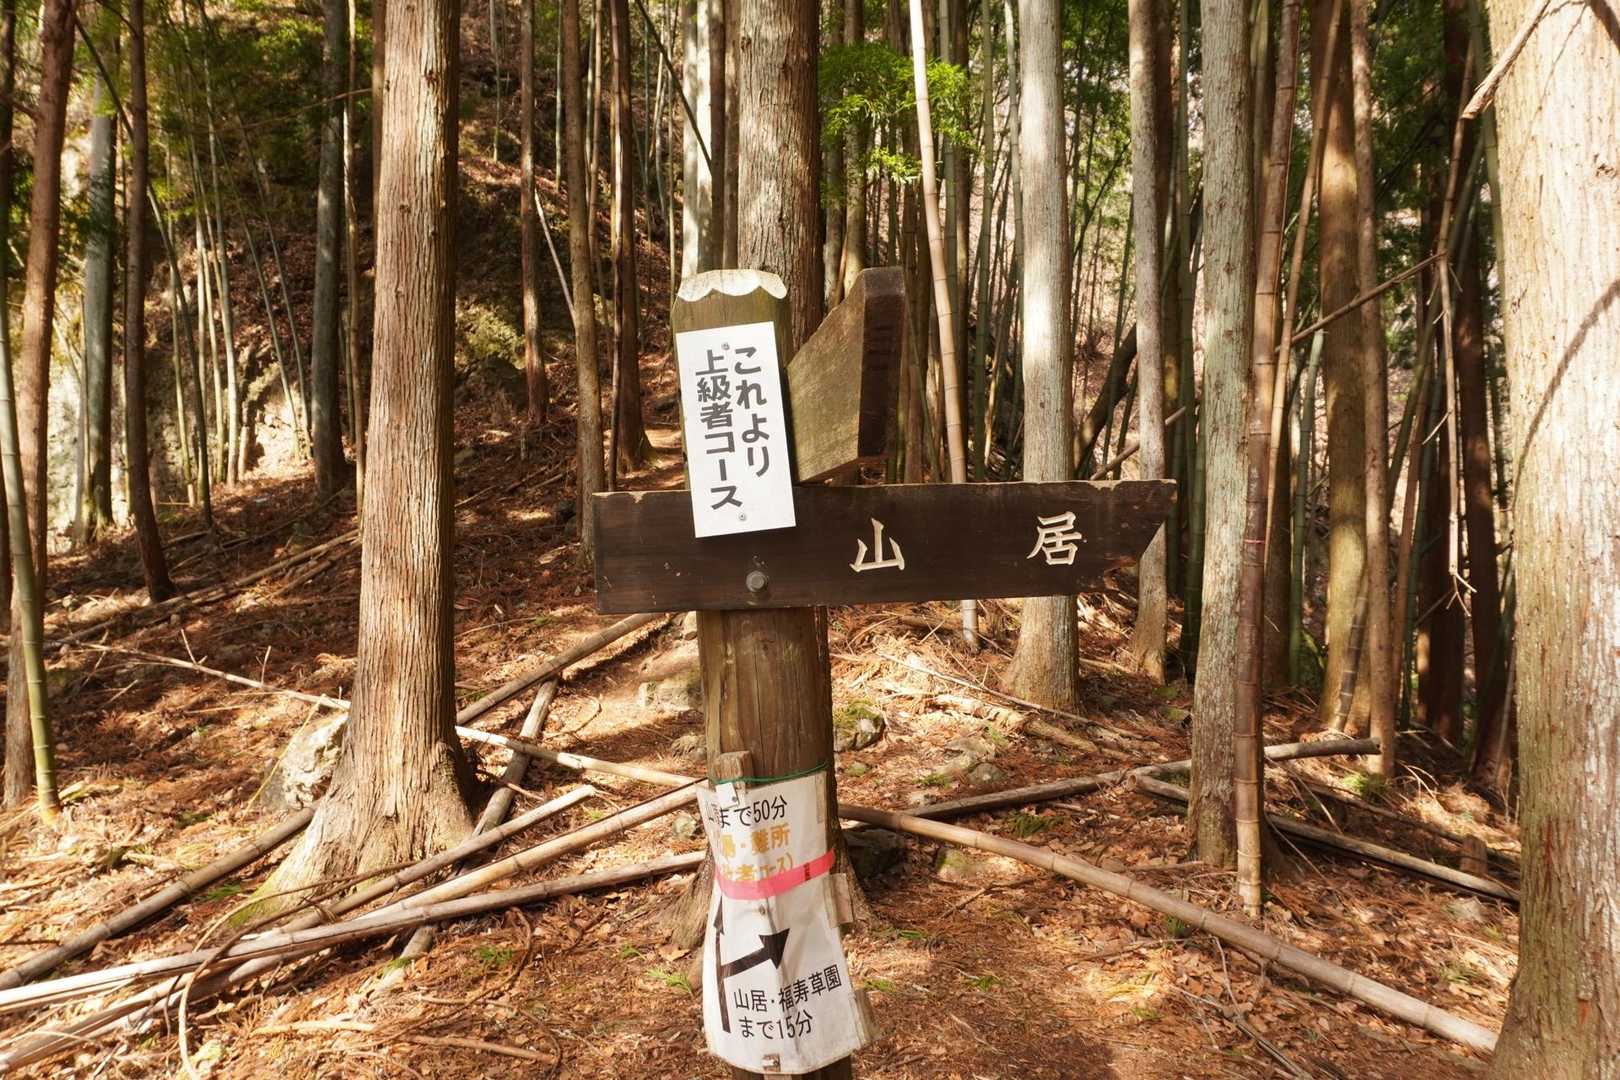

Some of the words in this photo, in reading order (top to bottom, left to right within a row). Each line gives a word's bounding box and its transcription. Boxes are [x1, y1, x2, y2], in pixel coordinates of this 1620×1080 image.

[695, 349, 743, 510] 上級者コース
[734, 346, 770, 477] これより
[707, 795, 788, 828] まで50分
[733, 964, 842, 1013] 山居・福寿草園
[738, 1009, 814, 1040] まで15分
